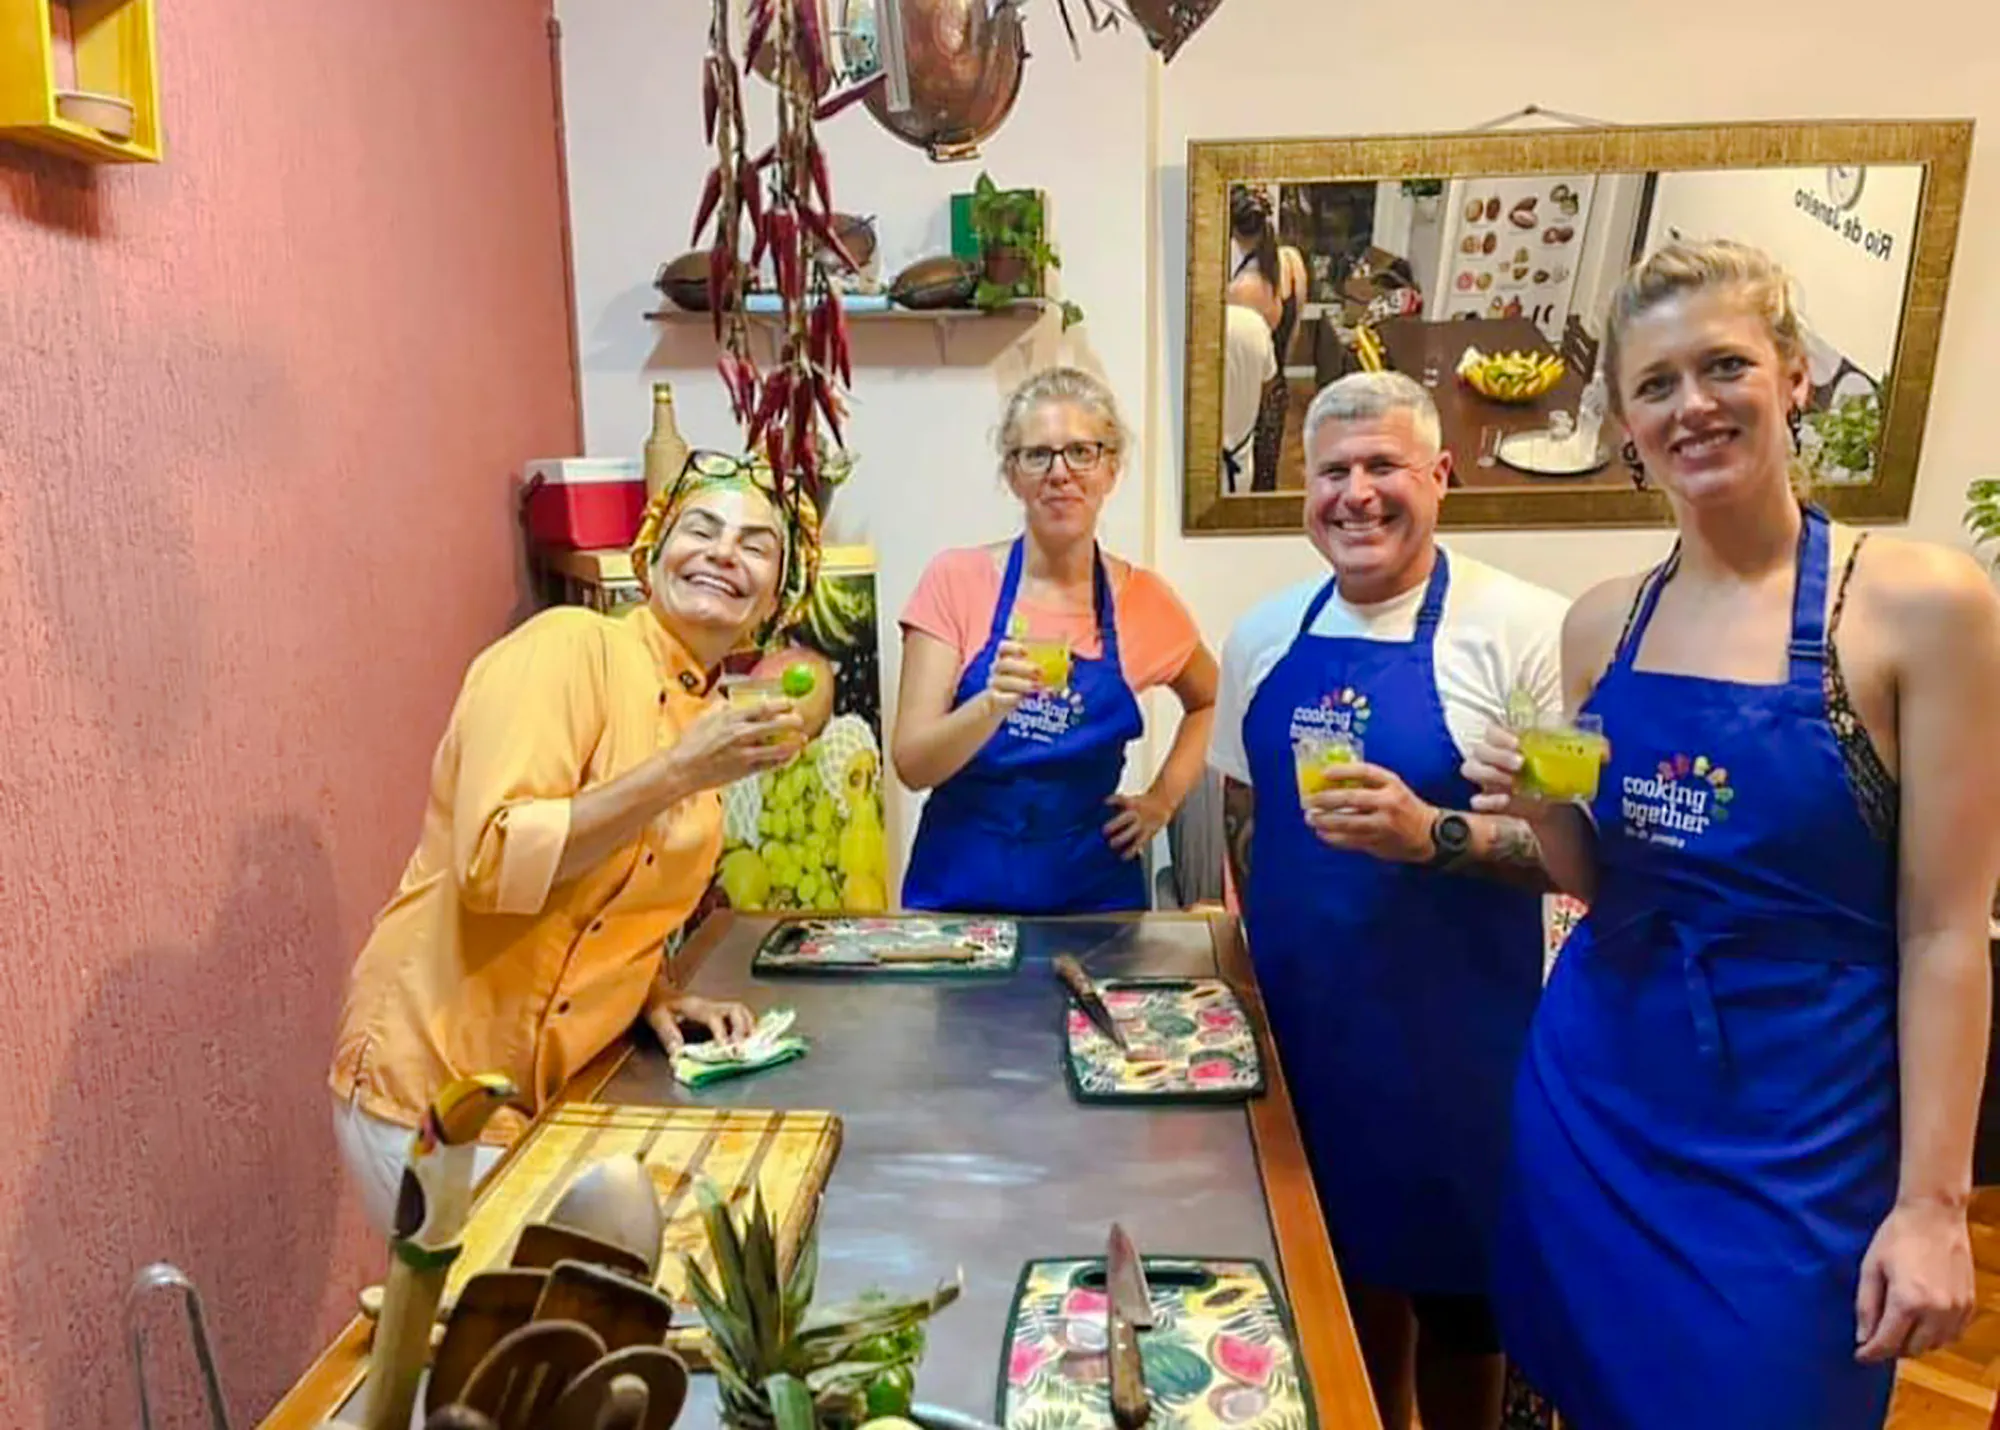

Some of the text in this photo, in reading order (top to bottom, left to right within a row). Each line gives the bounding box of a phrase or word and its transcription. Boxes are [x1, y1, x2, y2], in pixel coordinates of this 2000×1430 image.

[1293, 705, 1352, 732] cooking
[1623, 774, 1708, 814] cooking
[1622, 796, 1710, 834] together
